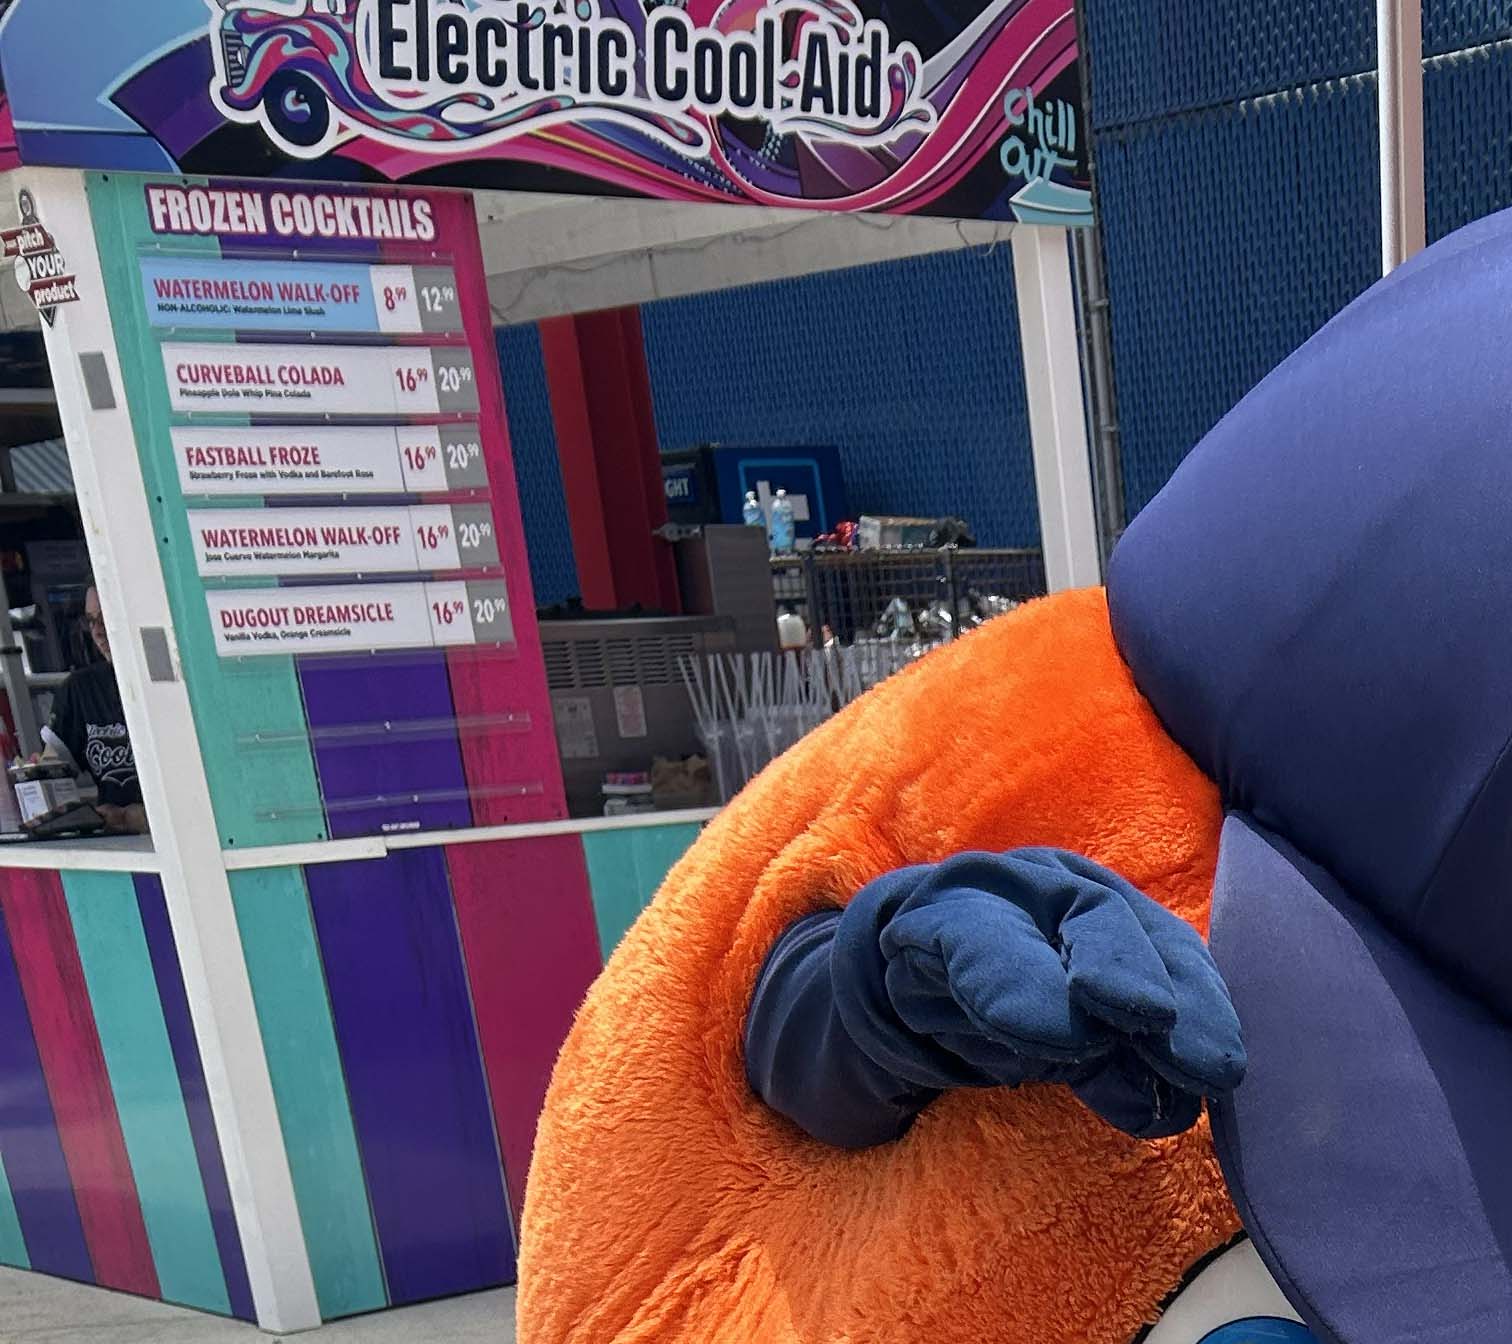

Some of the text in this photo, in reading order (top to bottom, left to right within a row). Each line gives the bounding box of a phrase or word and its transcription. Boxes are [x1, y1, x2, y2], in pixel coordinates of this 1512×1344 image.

[379, 0, 881, 119] Electric Cool Aid
[1004, 86, 1076, 155] Chill
[148, 188, 436, 242] FROZEN COCKTAILS
[15, 227, 45, 257] pitch
[28, 254, 65, 280] YOUR
[34, 281, 75, 307] product
[153, 278, 274, 301] WATERMELON
[276, 282, 361, 303] WALK-OFF
[233, 304, 282, 315] Watermelon
[176, 364, 275, 384] CURVEBALL
[277, 365, 345, 386] COLADA
[179, 388, 220, 399] Pineapple
[242, 388, 264, 399] Whip
[283, 389, 312, 399] Colada
[185, 446, 267, 467] FASTBALL
[269, 445, 321, 466] FROZE
[189, 470, 234, 481] Strawberry
[259, 470, 277, 479] with
[278, 469, 303, 479] Vodka
[304, 469, 320, 479] and
[663, 477, 691, 498] GHT
[201, 526, 318, 548] WATERMELON
[320, 525, 401, 546] WALK-OFF
[223, 551, 252, 561] Cuervo
[252, 550, 302, 561] Watermelon
[302, 549, 340, 561] Margarita
[220, 607, 290, 629] DUGOUT
[293, 602, 395, 626] DREAMSICLE
[224, 627, 352, 643] Vanilla Vodka, Orange Creamsicle
